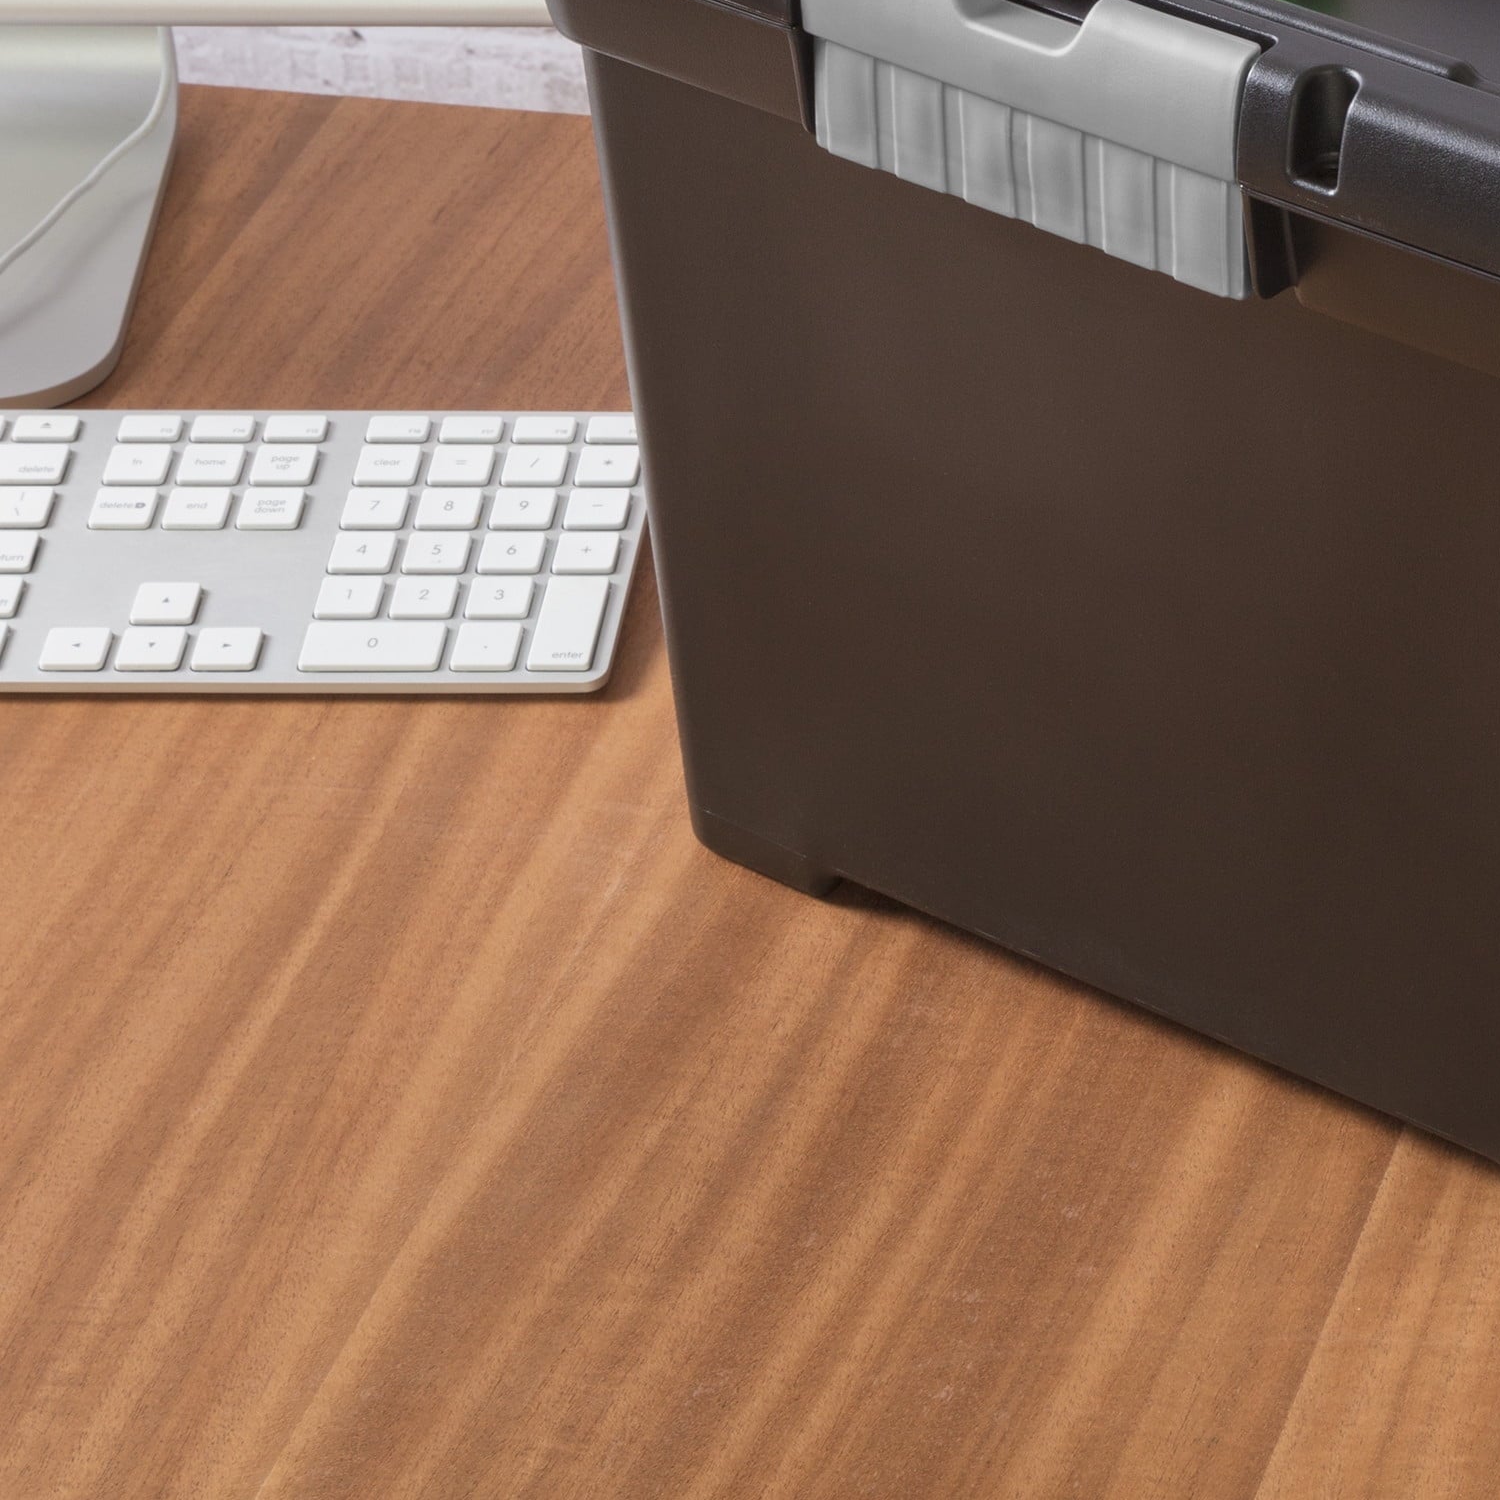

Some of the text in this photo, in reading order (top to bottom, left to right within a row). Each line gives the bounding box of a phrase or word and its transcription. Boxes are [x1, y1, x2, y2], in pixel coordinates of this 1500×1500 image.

[194, 458, 226, 466] home
[270, 455, 300, 463] page
[373, 458, 401, 466] clear
[18, 465, 55, 473] delete
[257, 499, 286, 507] page
[370, 500, 530, 512] 7 8 9
[254, 506, 285, 514] down
[355, 544, 517, 556] 4 5 6
[419, 589, 430, 601] 2
[493, 589, 505, 601] 3
[367, 637, 379, 649] 0
[551, 651, 585, 659] enter
